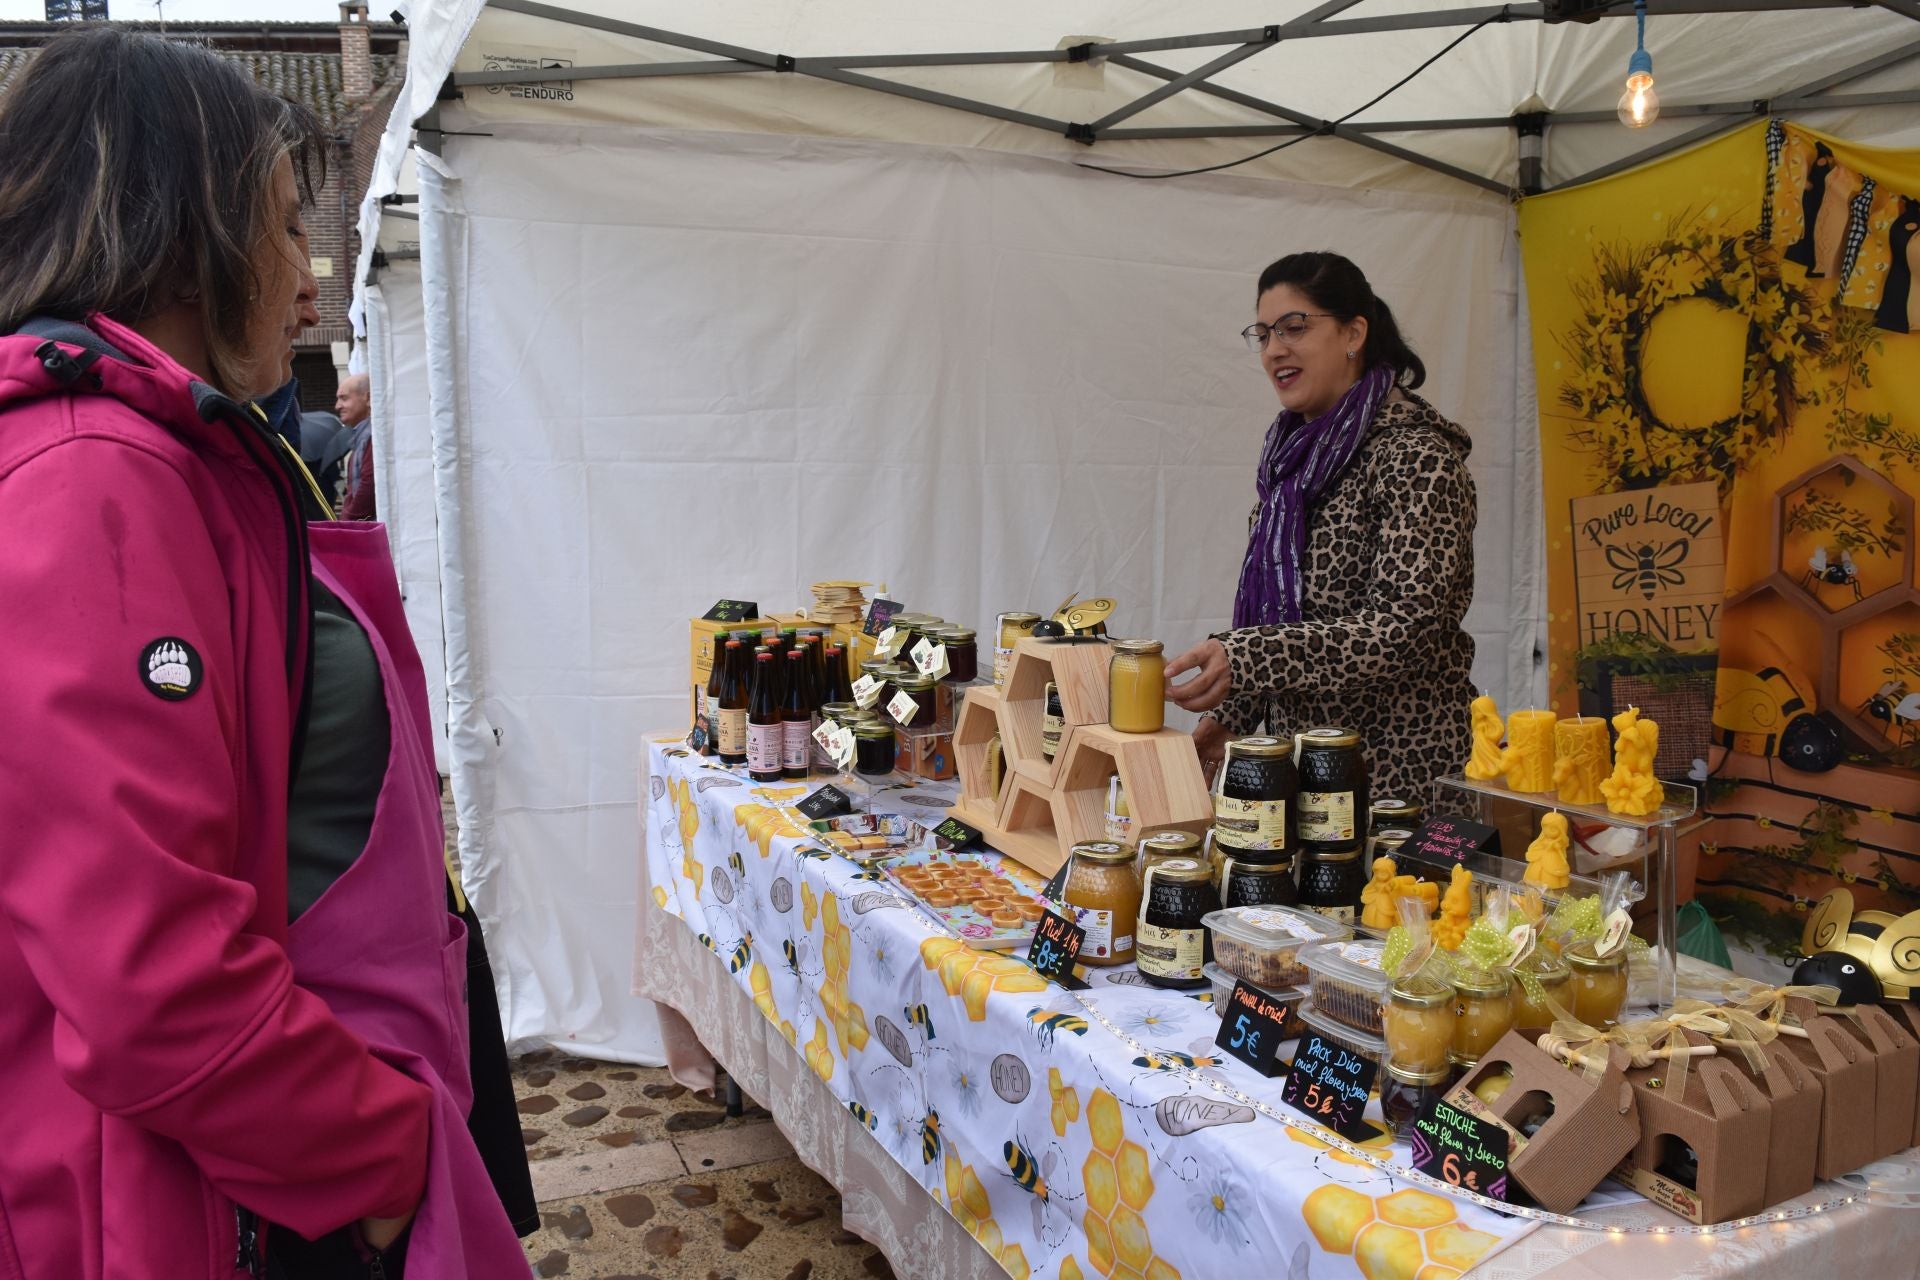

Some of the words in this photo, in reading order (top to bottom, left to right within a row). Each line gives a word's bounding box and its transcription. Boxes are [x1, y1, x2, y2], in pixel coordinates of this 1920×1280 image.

[524, 87, 574, 101] ENDURO
[1582, 503, 1638, 547] Pure
[1644, 494, 1714, 540] Local
[1586, 603, 1721, 646] HONEY
[1041, 916, 1064, 942] Miel
[1235, 987, 1258, 1010] PANAL
[995, 1063, 1024, 1094] HONEY
[1316, 1066, 1344, 1092] flores
[1163, 1099, 1241, 1131] HONEY
[1435, 1103, 1480, 1140] ESTUCHE
[1464, 1145, 1474, 1162] y
[1475, 1142, 1504, 1170] brezo
[1656, 1179, 1677, 1195] Miel
